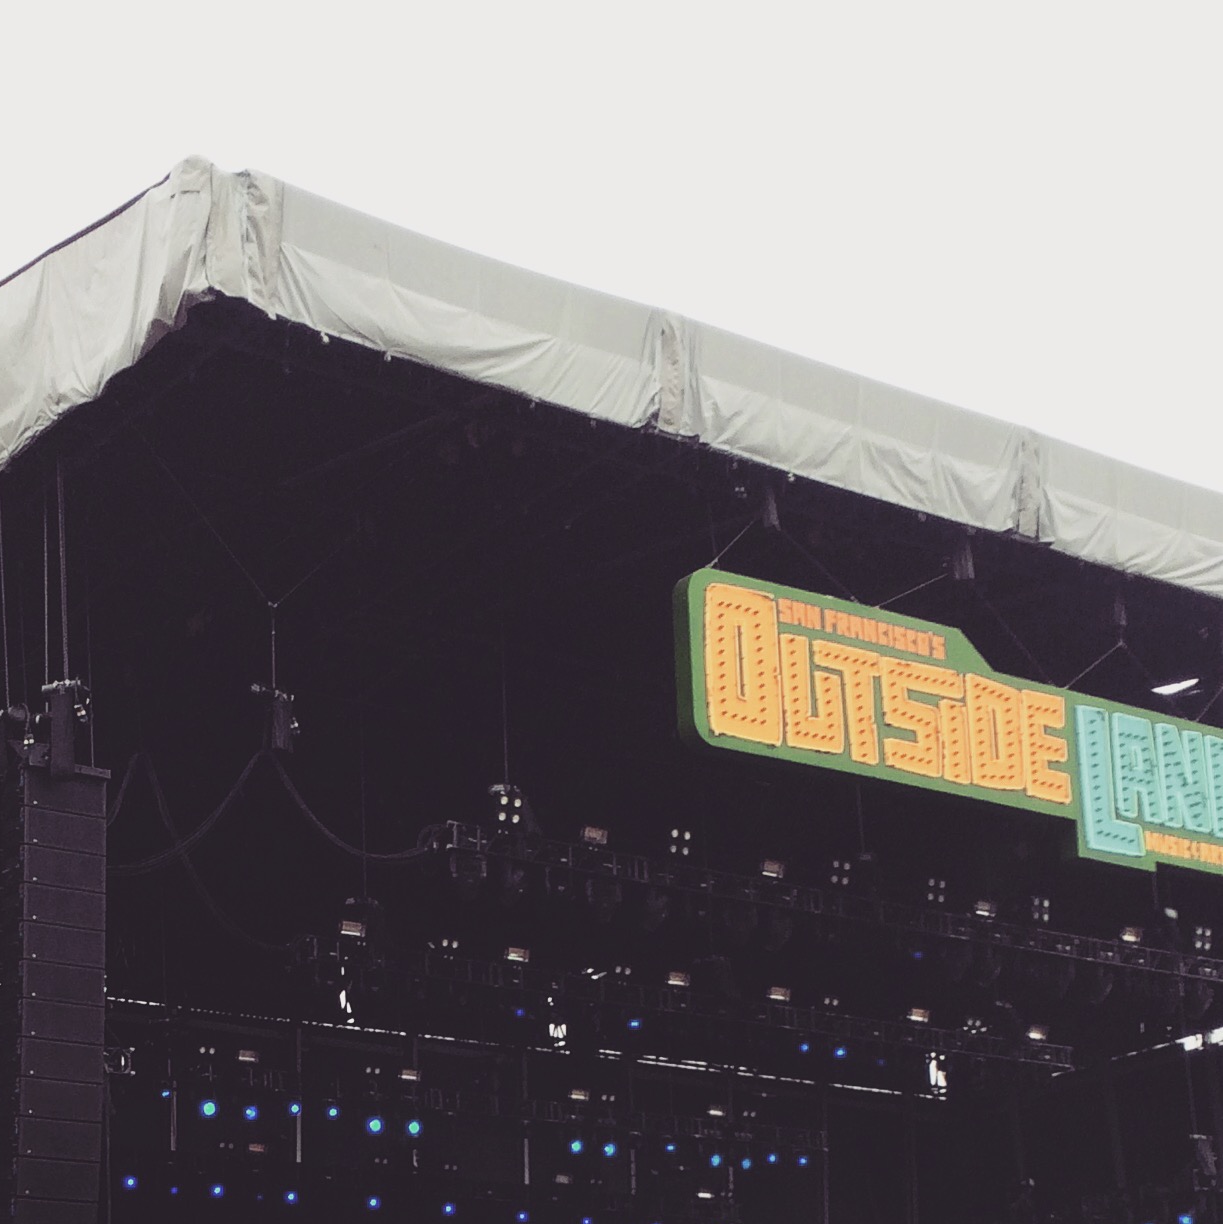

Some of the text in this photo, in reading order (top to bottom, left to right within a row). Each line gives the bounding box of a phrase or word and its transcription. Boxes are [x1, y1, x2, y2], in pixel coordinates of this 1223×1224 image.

[705, 583, 1072, 804] OUTSIDE
[777, 598, 946, 661] SAN FRANCISCO'S
